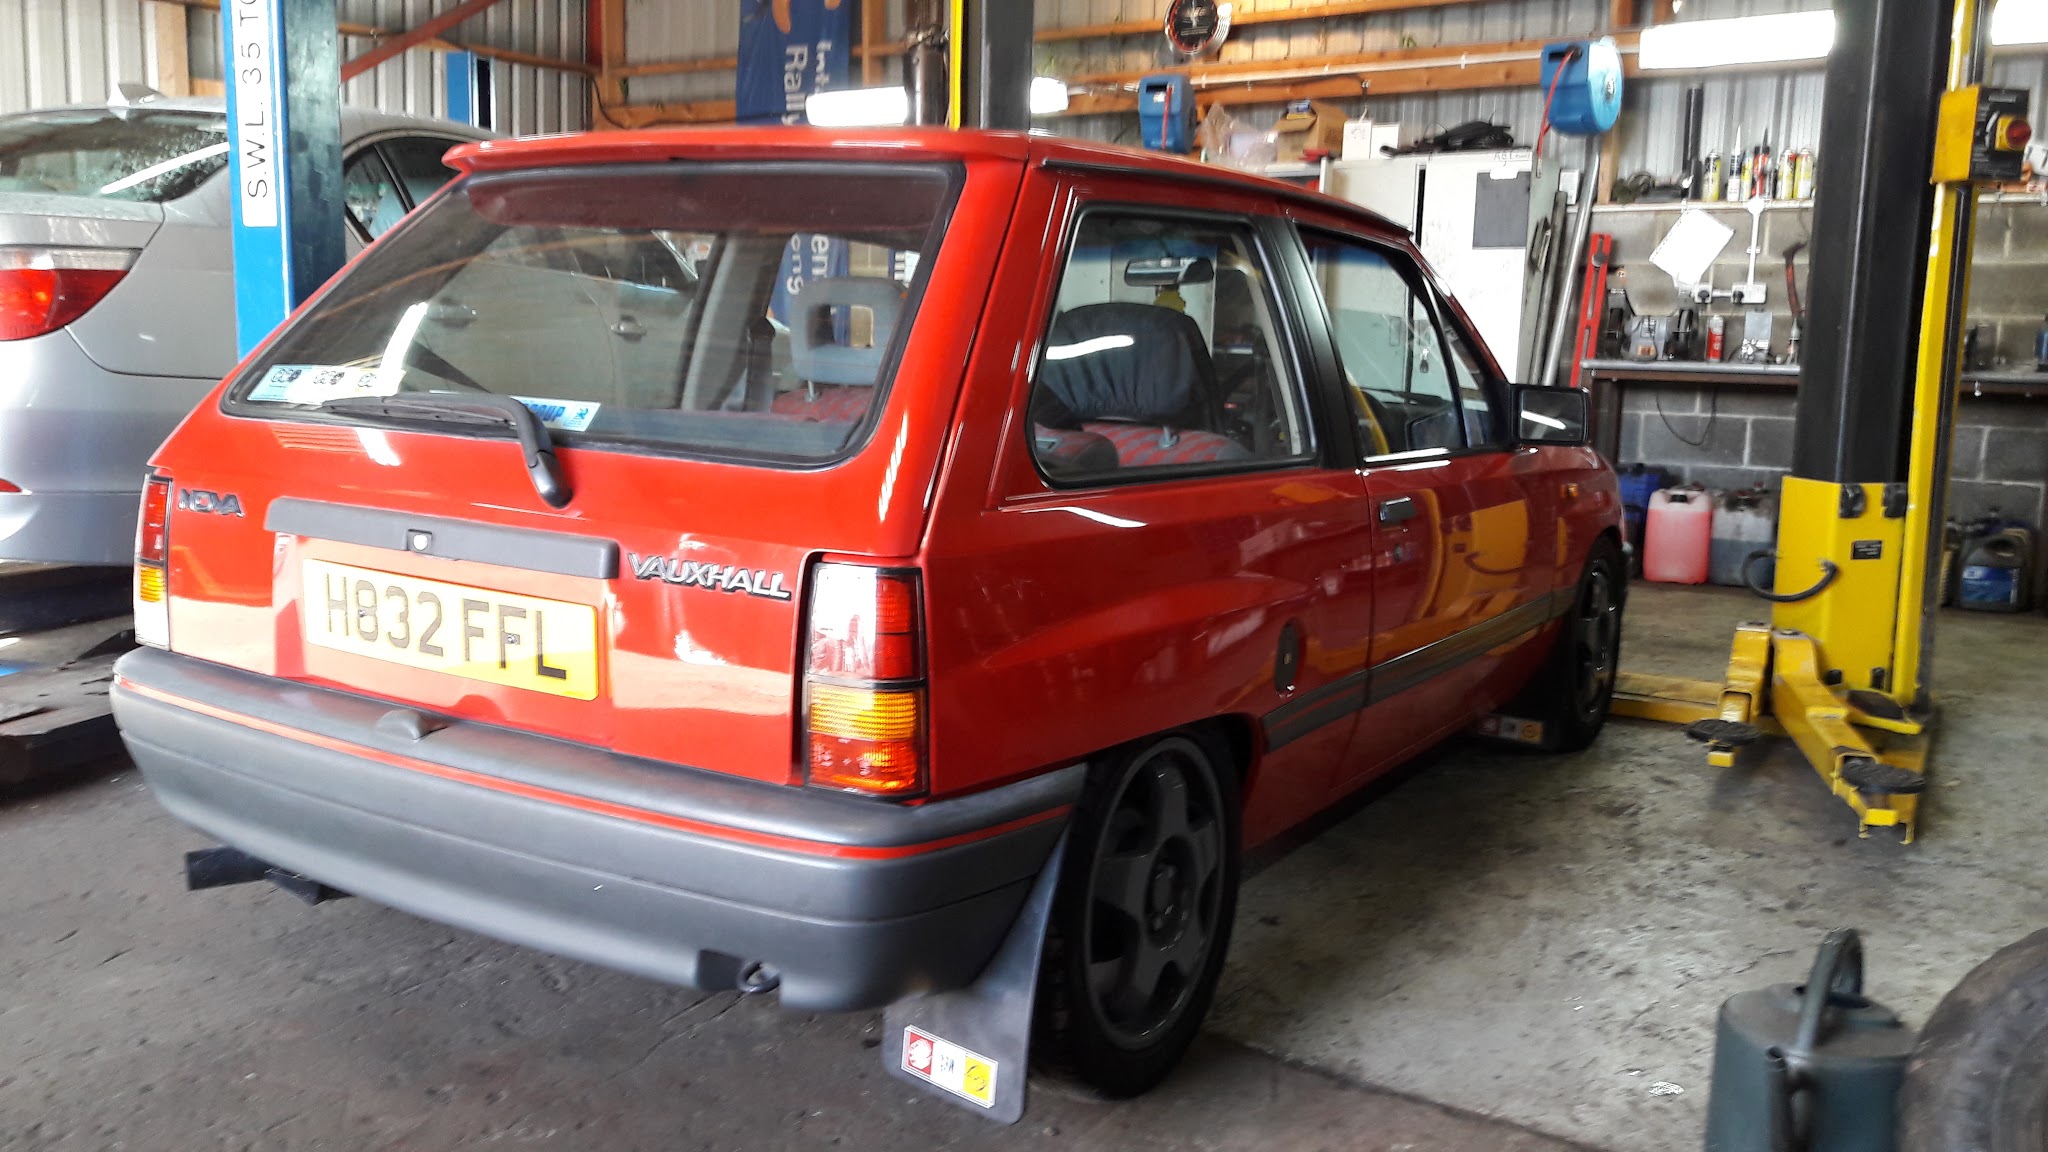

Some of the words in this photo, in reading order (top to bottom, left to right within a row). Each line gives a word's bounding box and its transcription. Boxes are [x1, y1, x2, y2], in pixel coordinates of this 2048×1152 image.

[178, 488, 245, 518] NOVA
[628, 553, 791, 601] VAUXHALL
[325, 573, 444, 657] H832
[461, 597, 567, 680] FFL
